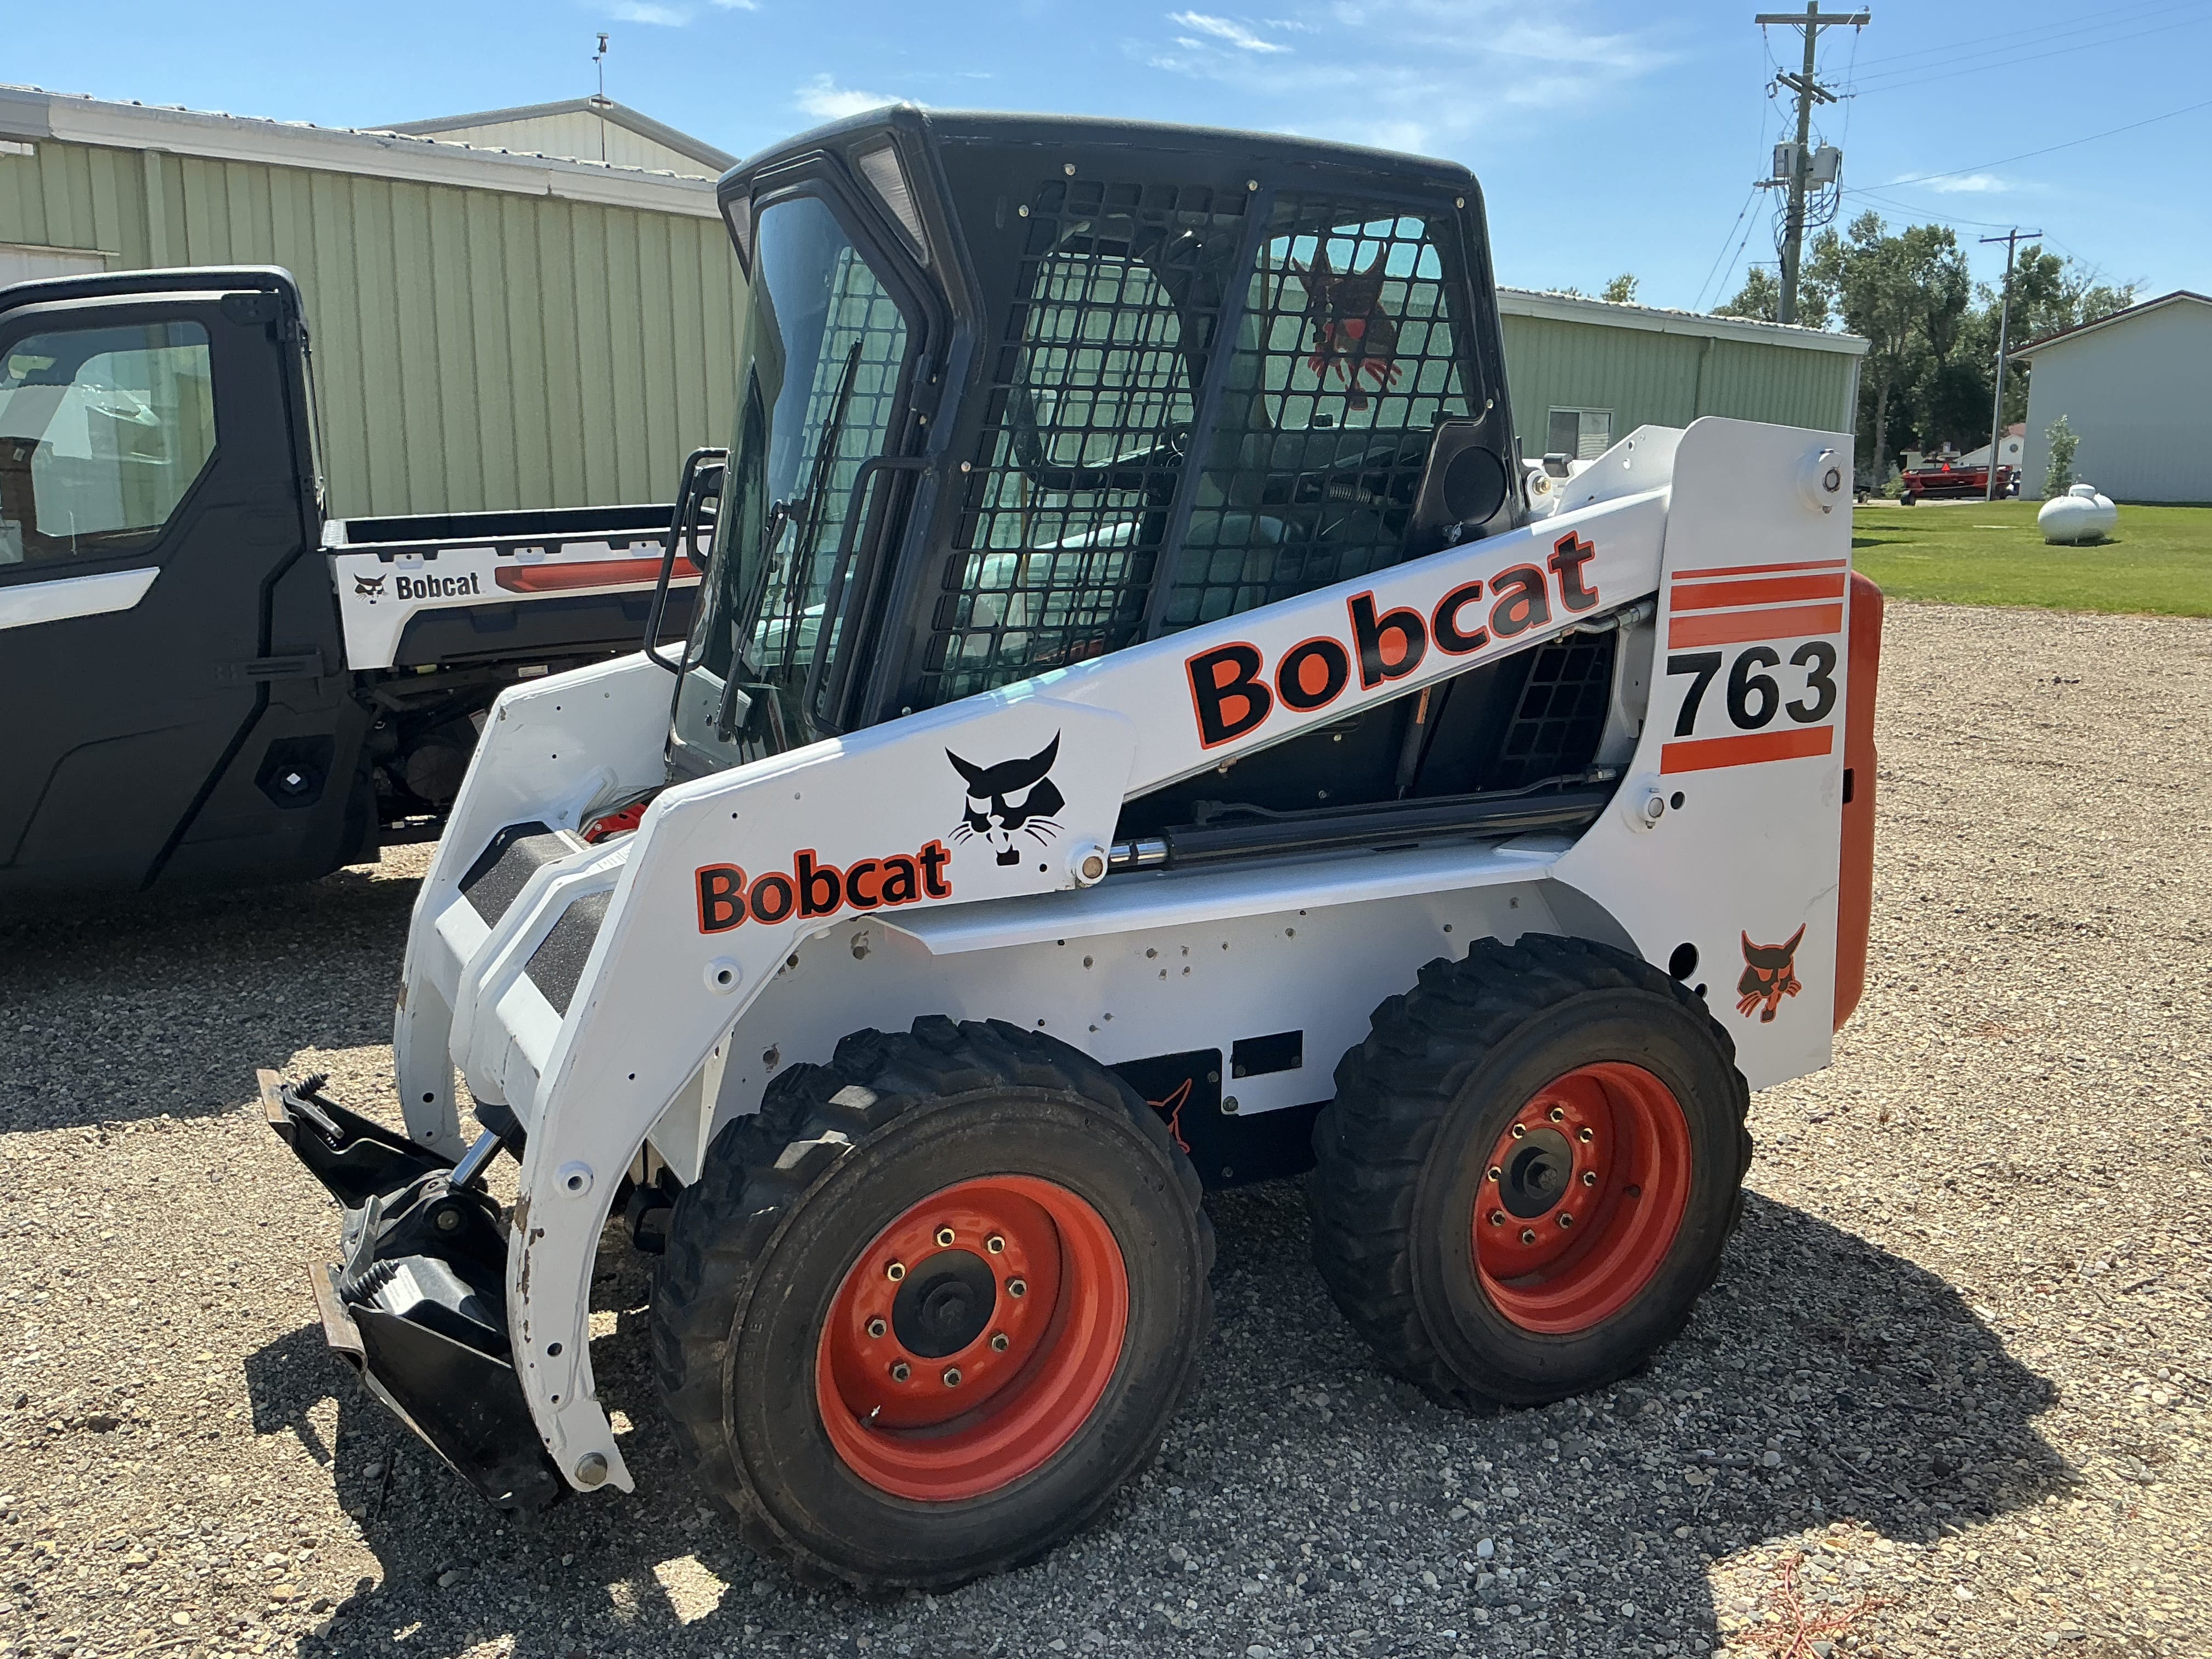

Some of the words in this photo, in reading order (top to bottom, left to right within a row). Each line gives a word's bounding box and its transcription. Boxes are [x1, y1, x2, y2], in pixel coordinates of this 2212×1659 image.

[396, 572, 480, 600] Bobcat
[1185, 530, 1599, 750] Bobcat
[1667, 641, 1837, 737] 763
[695, 839, 952, 934] Bobcat
